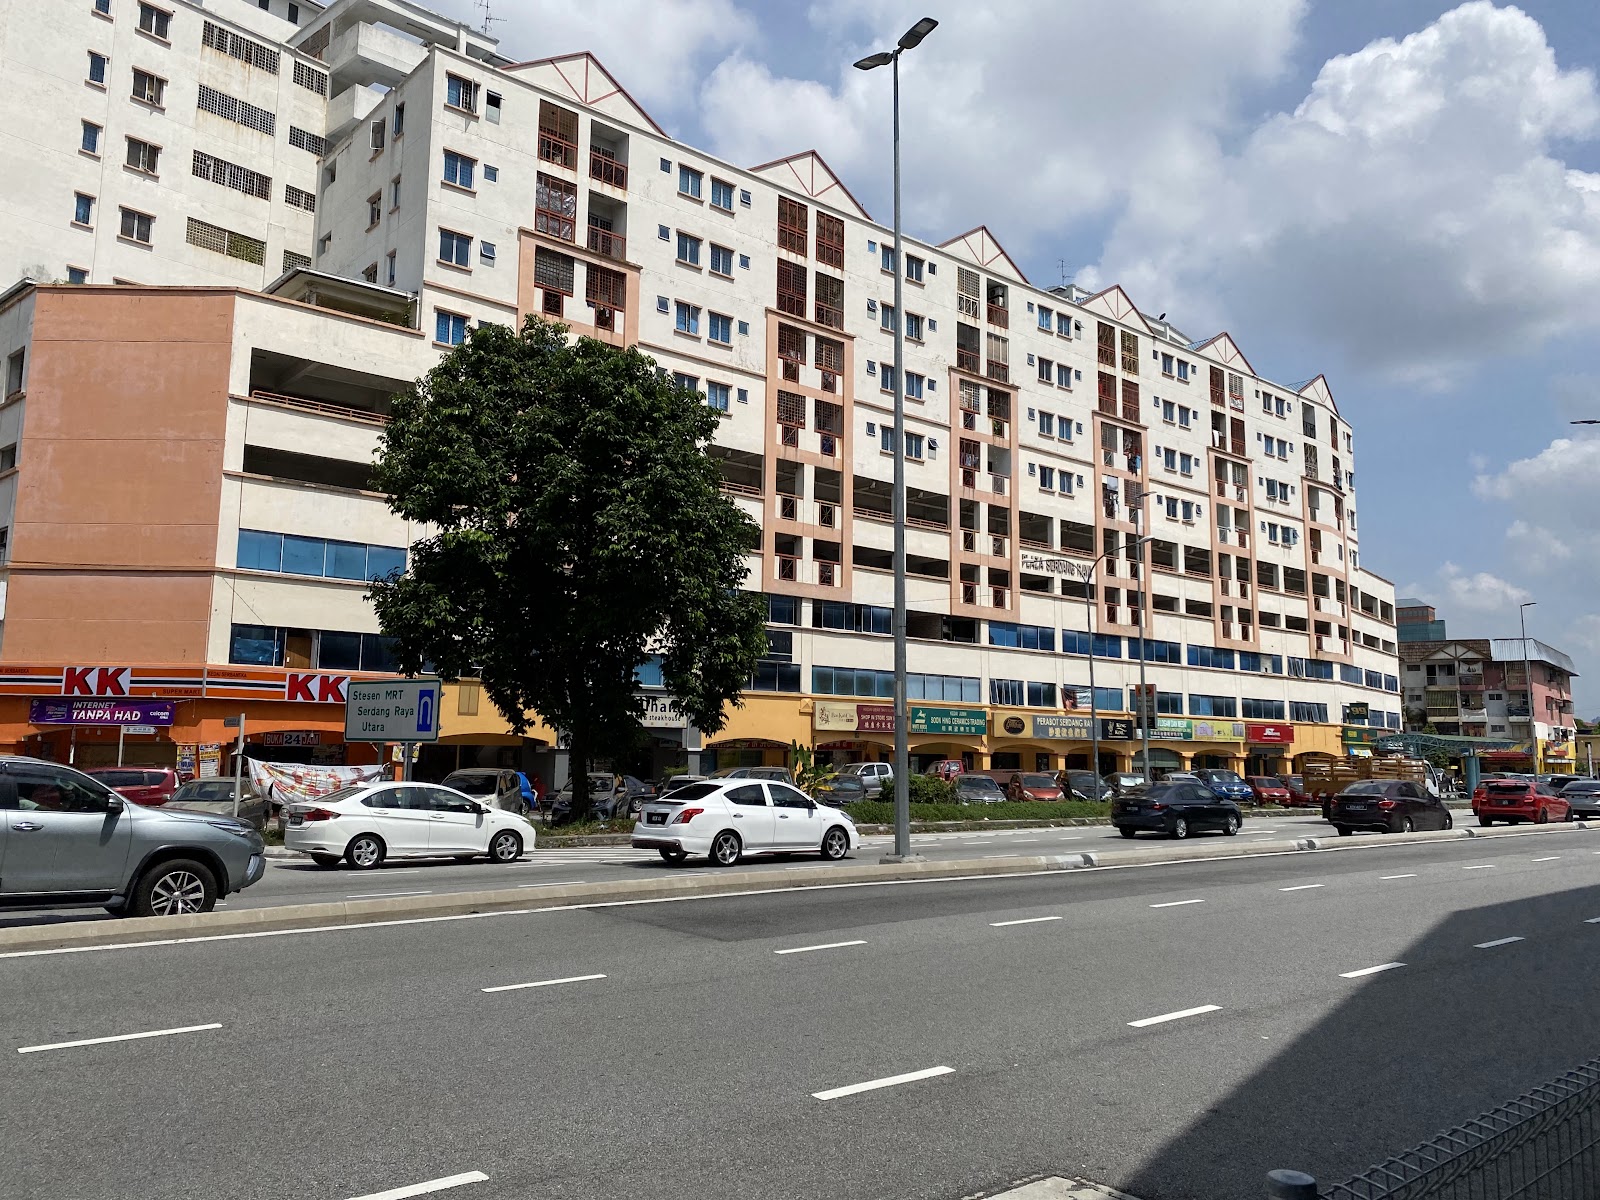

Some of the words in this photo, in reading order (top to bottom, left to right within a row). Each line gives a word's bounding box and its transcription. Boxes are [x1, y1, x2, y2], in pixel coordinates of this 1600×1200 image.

[63, 667, 129, 696] KK
[287, 673, 348, 703] KK
[353, 690, 381, 701] Stesen
[385, 689, 404, 700] MRT
[72, 701, 116, 709] INTERNET
[1351, 706, 1368, 715] 99
[71, 709, 111, 720] TANPA
[113, 710, 141, 721] HAD
[357, 706, 390, 718] Serdang
[394, 706, 414, 718] Raya
[362, 722, 385, 732] Utara
[1037, 717, 1059, 726] PERABOT
[1059, 718, 1083, 727] SERDANG
[266, 733, 283, 744] BUKA
[284, 733, 301, 745] 24
